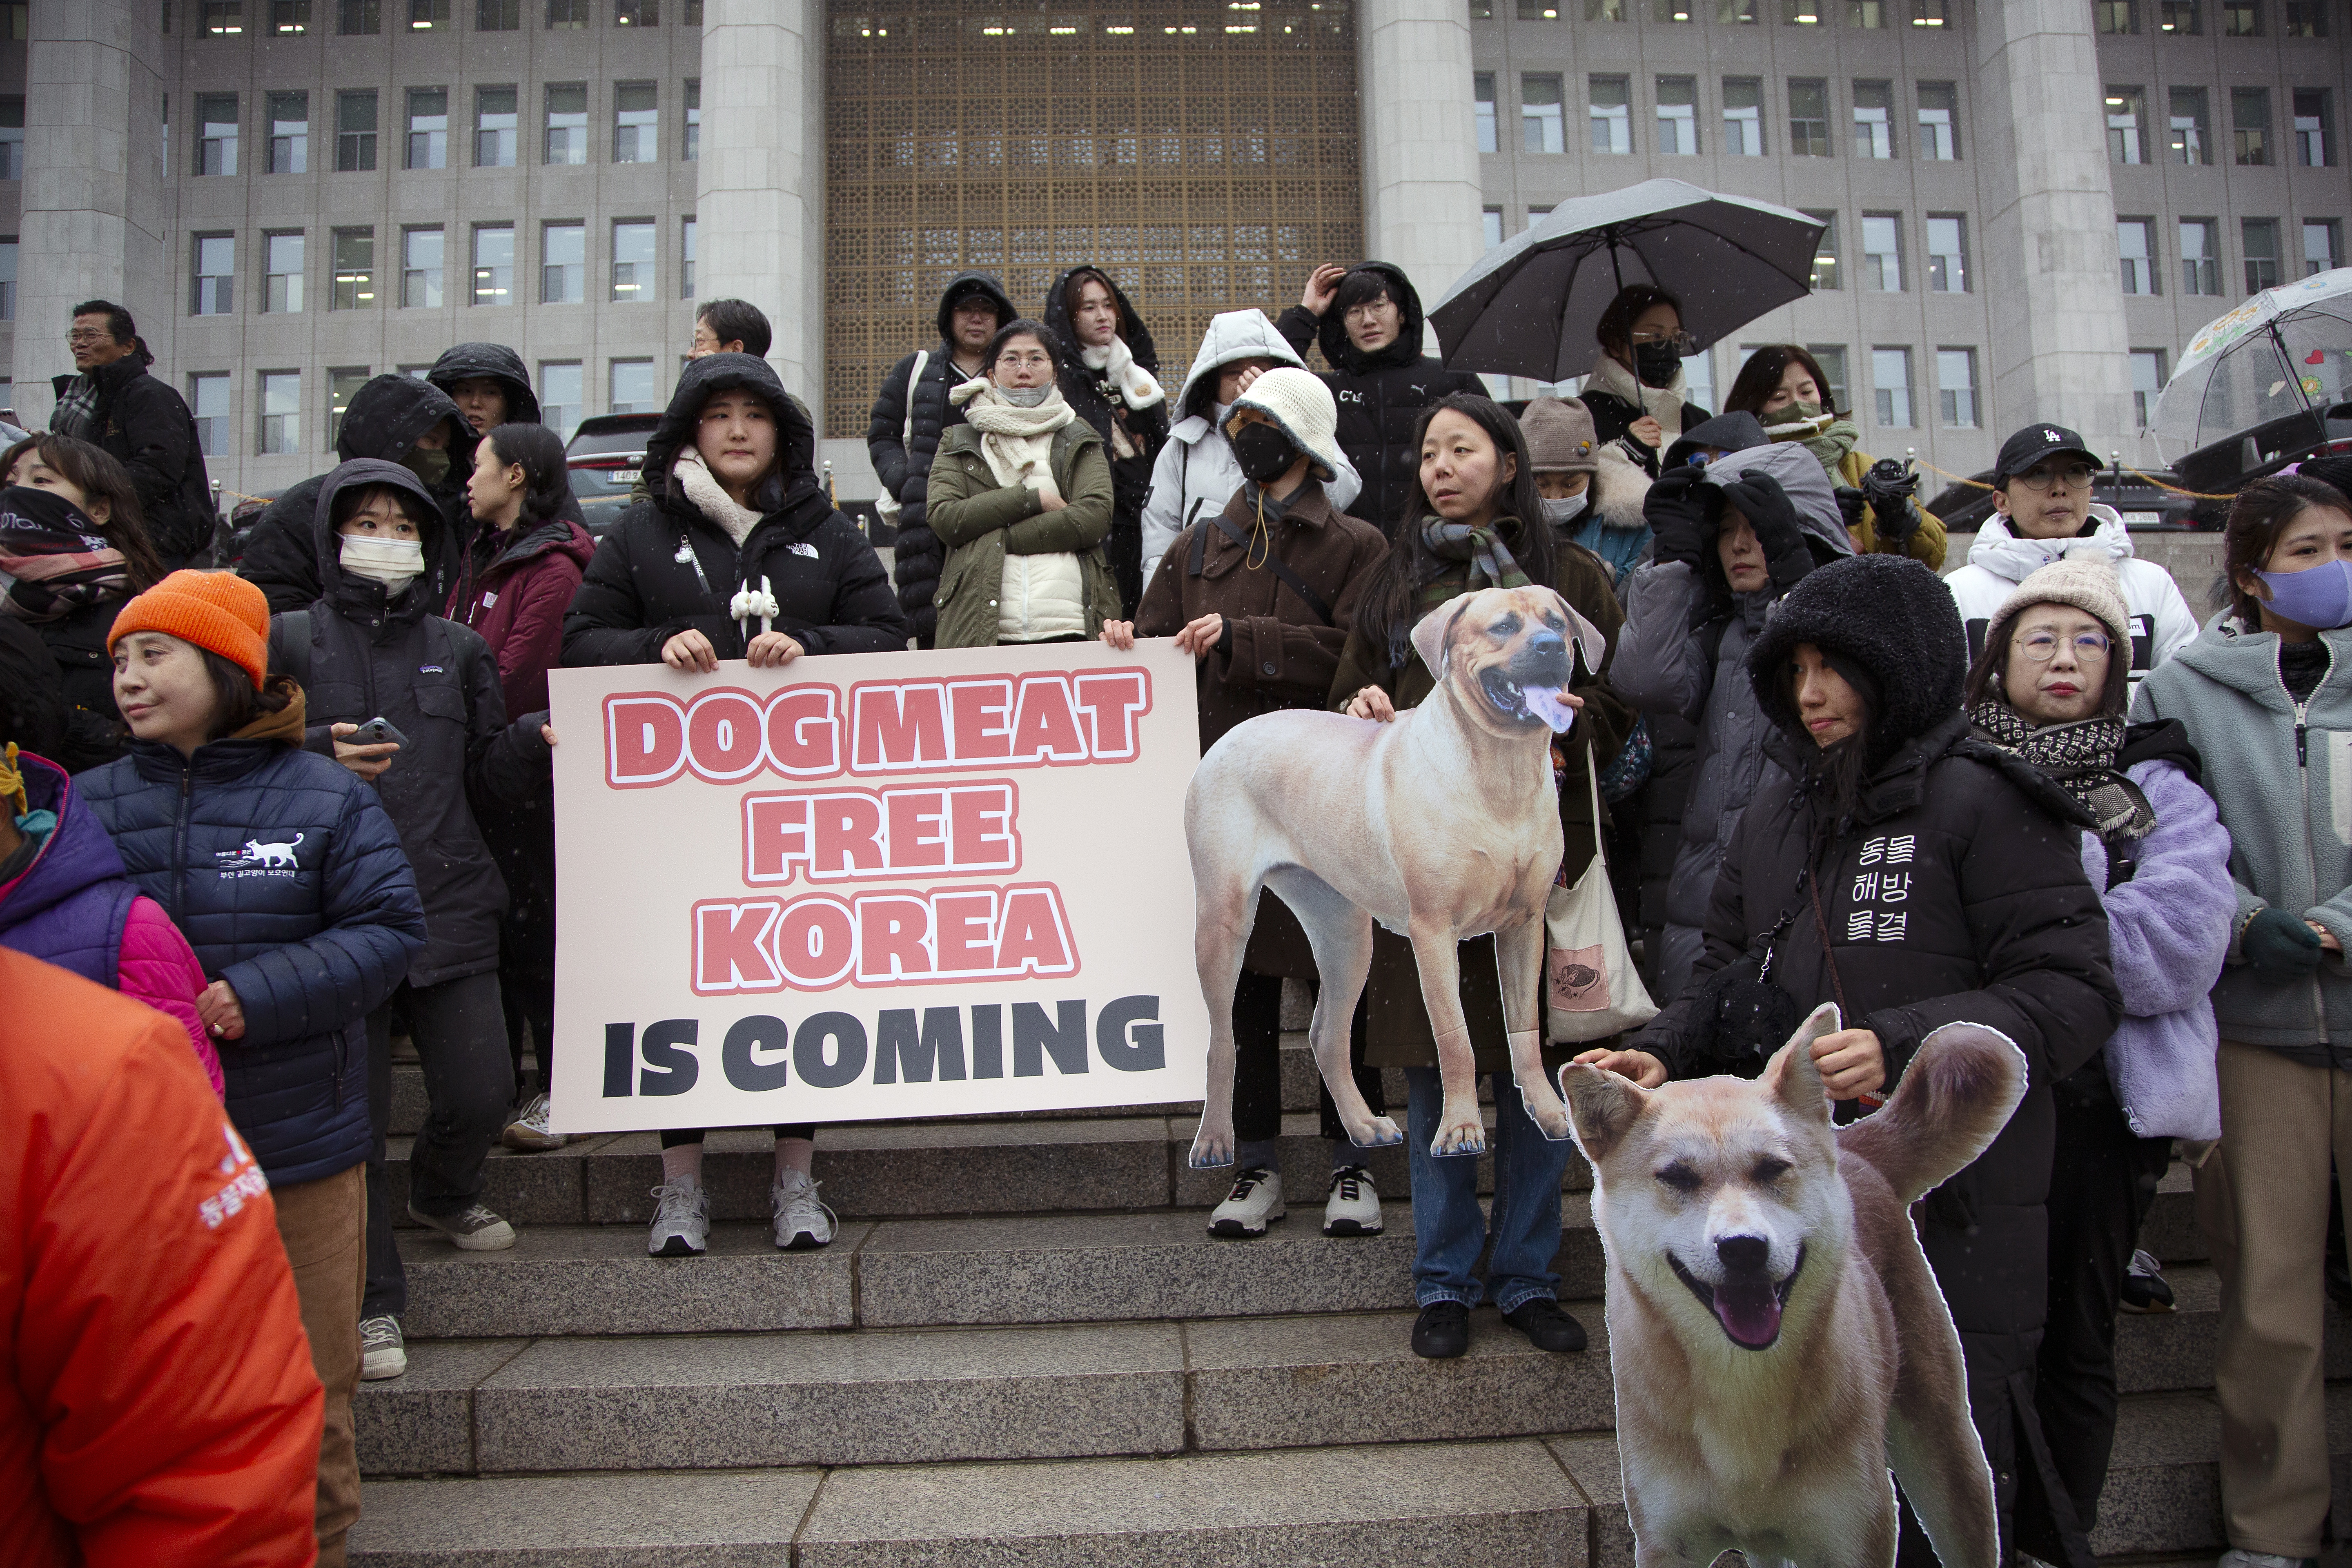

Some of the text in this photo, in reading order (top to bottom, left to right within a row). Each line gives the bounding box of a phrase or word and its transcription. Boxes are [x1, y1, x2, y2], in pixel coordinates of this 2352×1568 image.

[2043, 429, 2061, 442] LA
[606, 671, 1148, 784] DOG MEAT
[746, 784, 1017, 883] FREE
[1859, 835, 1915, 866] 동물
[237, 869, 265, 878] 길고양이
[268, 869, 295, 878] 보호연대
[1853, 872, 1913, 902] 해방
[695, 886, 1076, 993] KOREA
[1847, 910, 1907, 941] 물결
[602, 995, 1166, 1098] IS COMING
